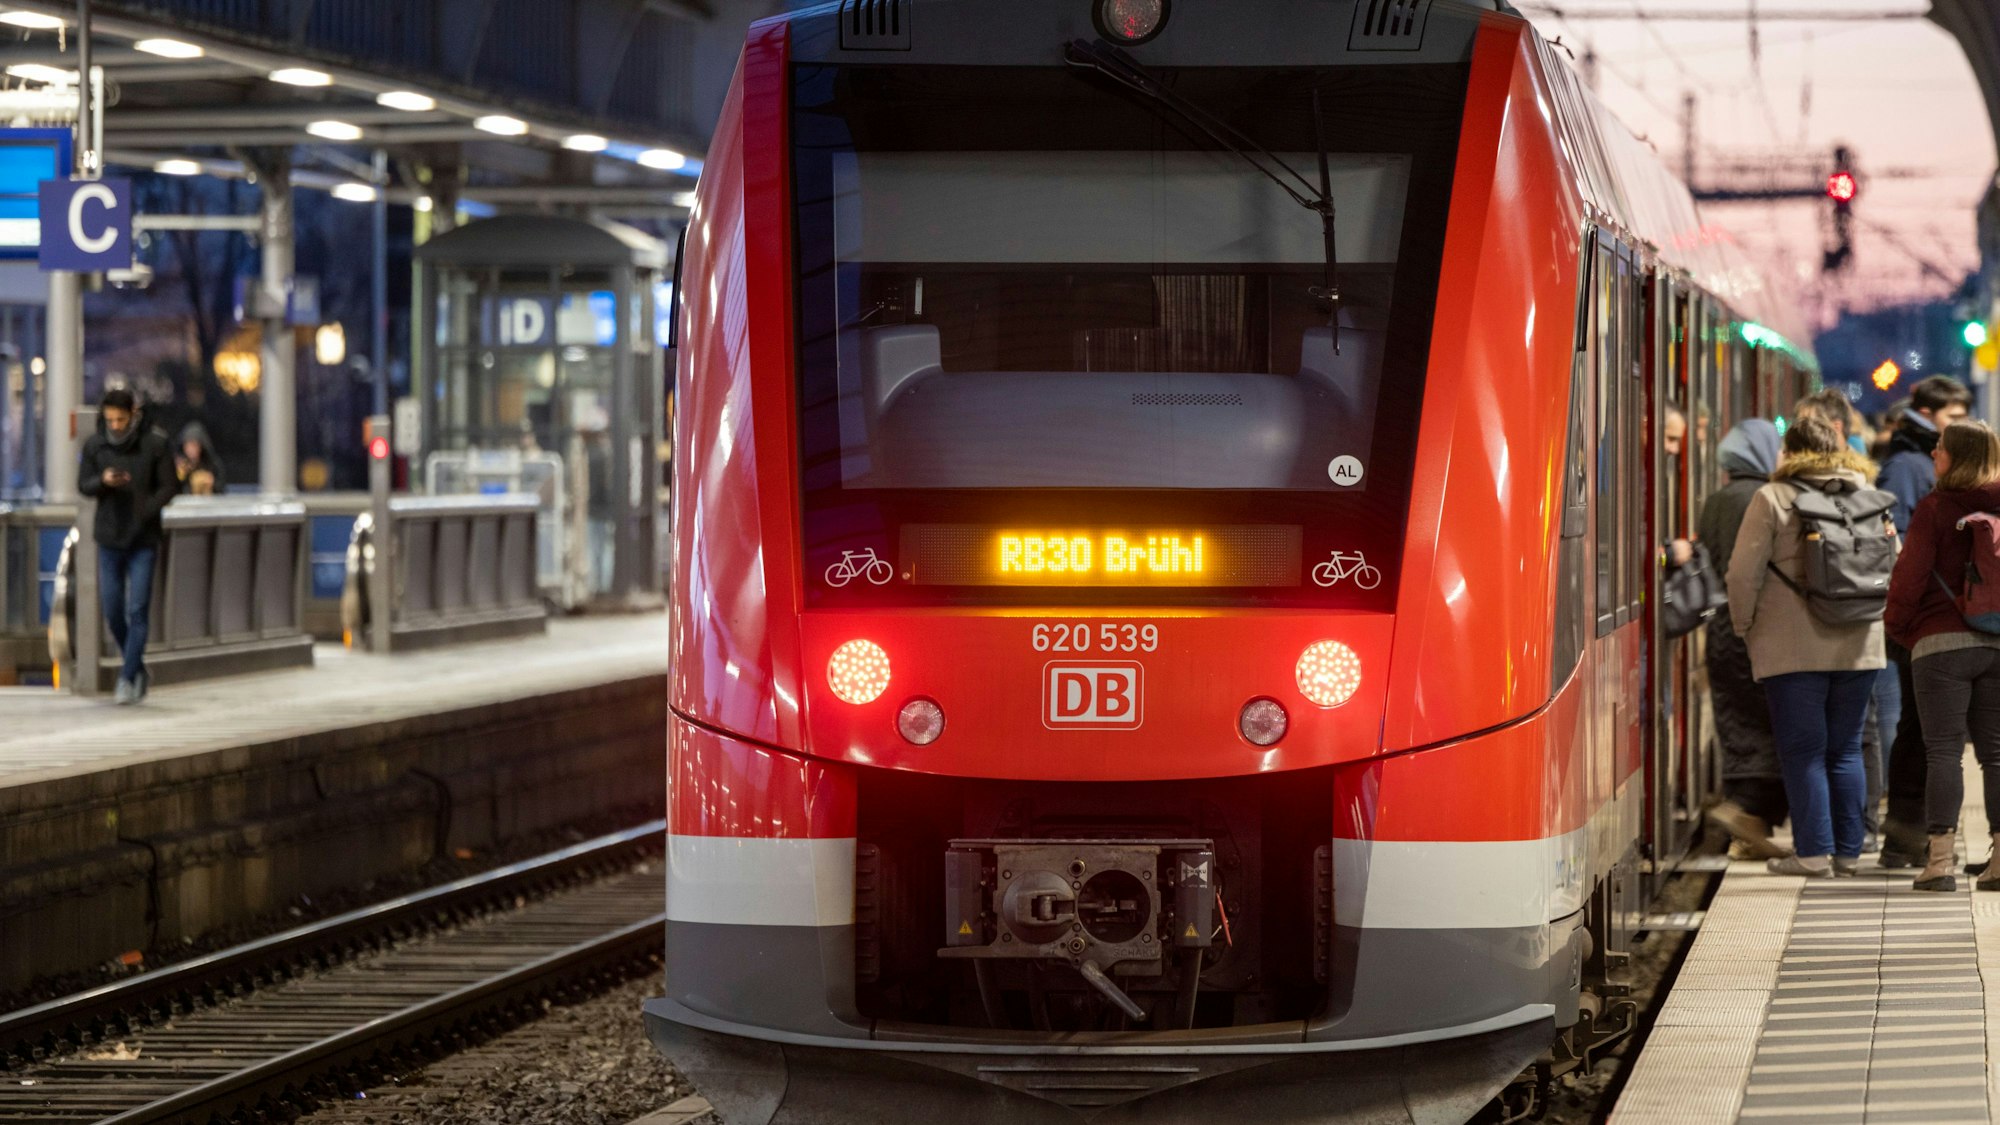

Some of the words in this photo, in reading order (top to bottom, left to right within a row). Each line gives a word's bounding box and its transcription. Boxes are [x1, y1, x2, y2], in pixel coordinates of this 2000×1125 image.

[68, 182, 119, 254] C
[1335, 464, 1357, 478] AL
[1001, 536, 1092, 572] RB30
[1105, 536, 1203, 572] Brühl
[1032, 623, 1091, 652] 620
[1100, 623, 1159, 652] 539
[1056, 672, 1131, 718] DB
